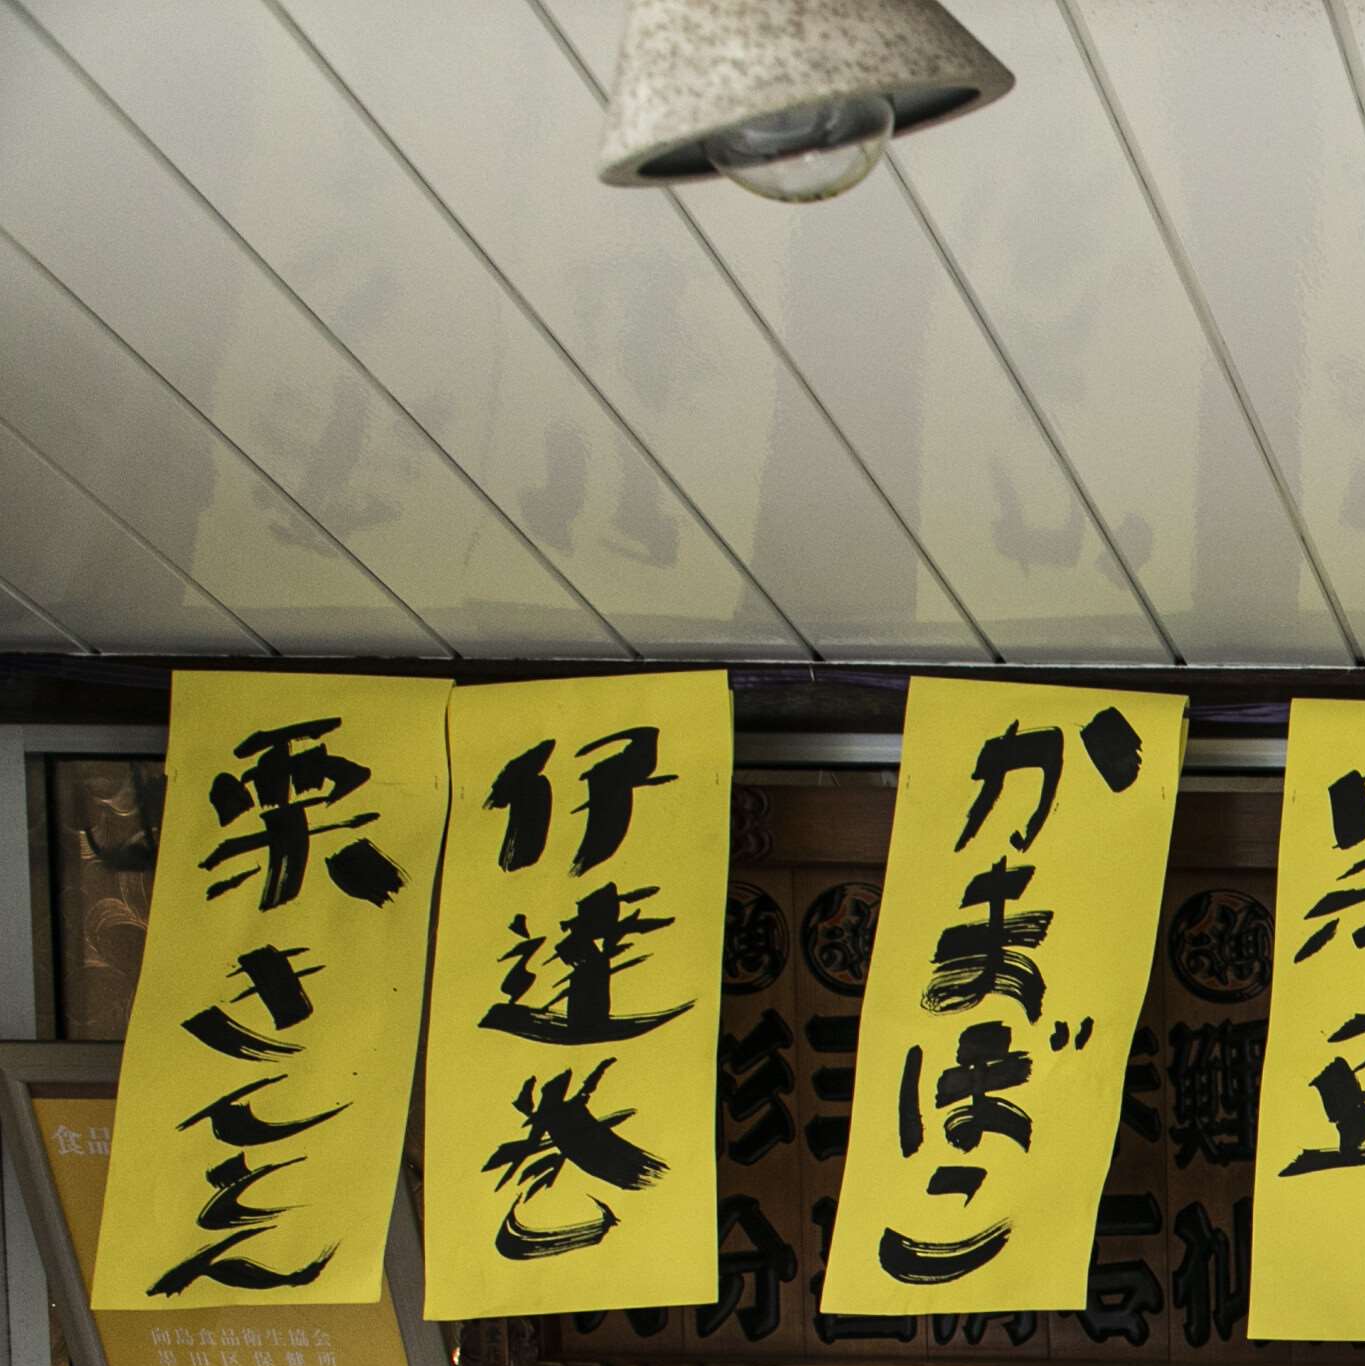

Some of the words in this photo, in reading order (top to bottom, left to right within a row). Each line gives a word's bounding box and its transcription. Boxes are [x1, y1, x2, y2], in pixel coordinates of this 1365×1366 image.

[146, 716, 409, 1299] 栗きんとん
[478, 727, 697, 1261] 伊達巻
[877, 705, 1144, 1286] かまぼこ
